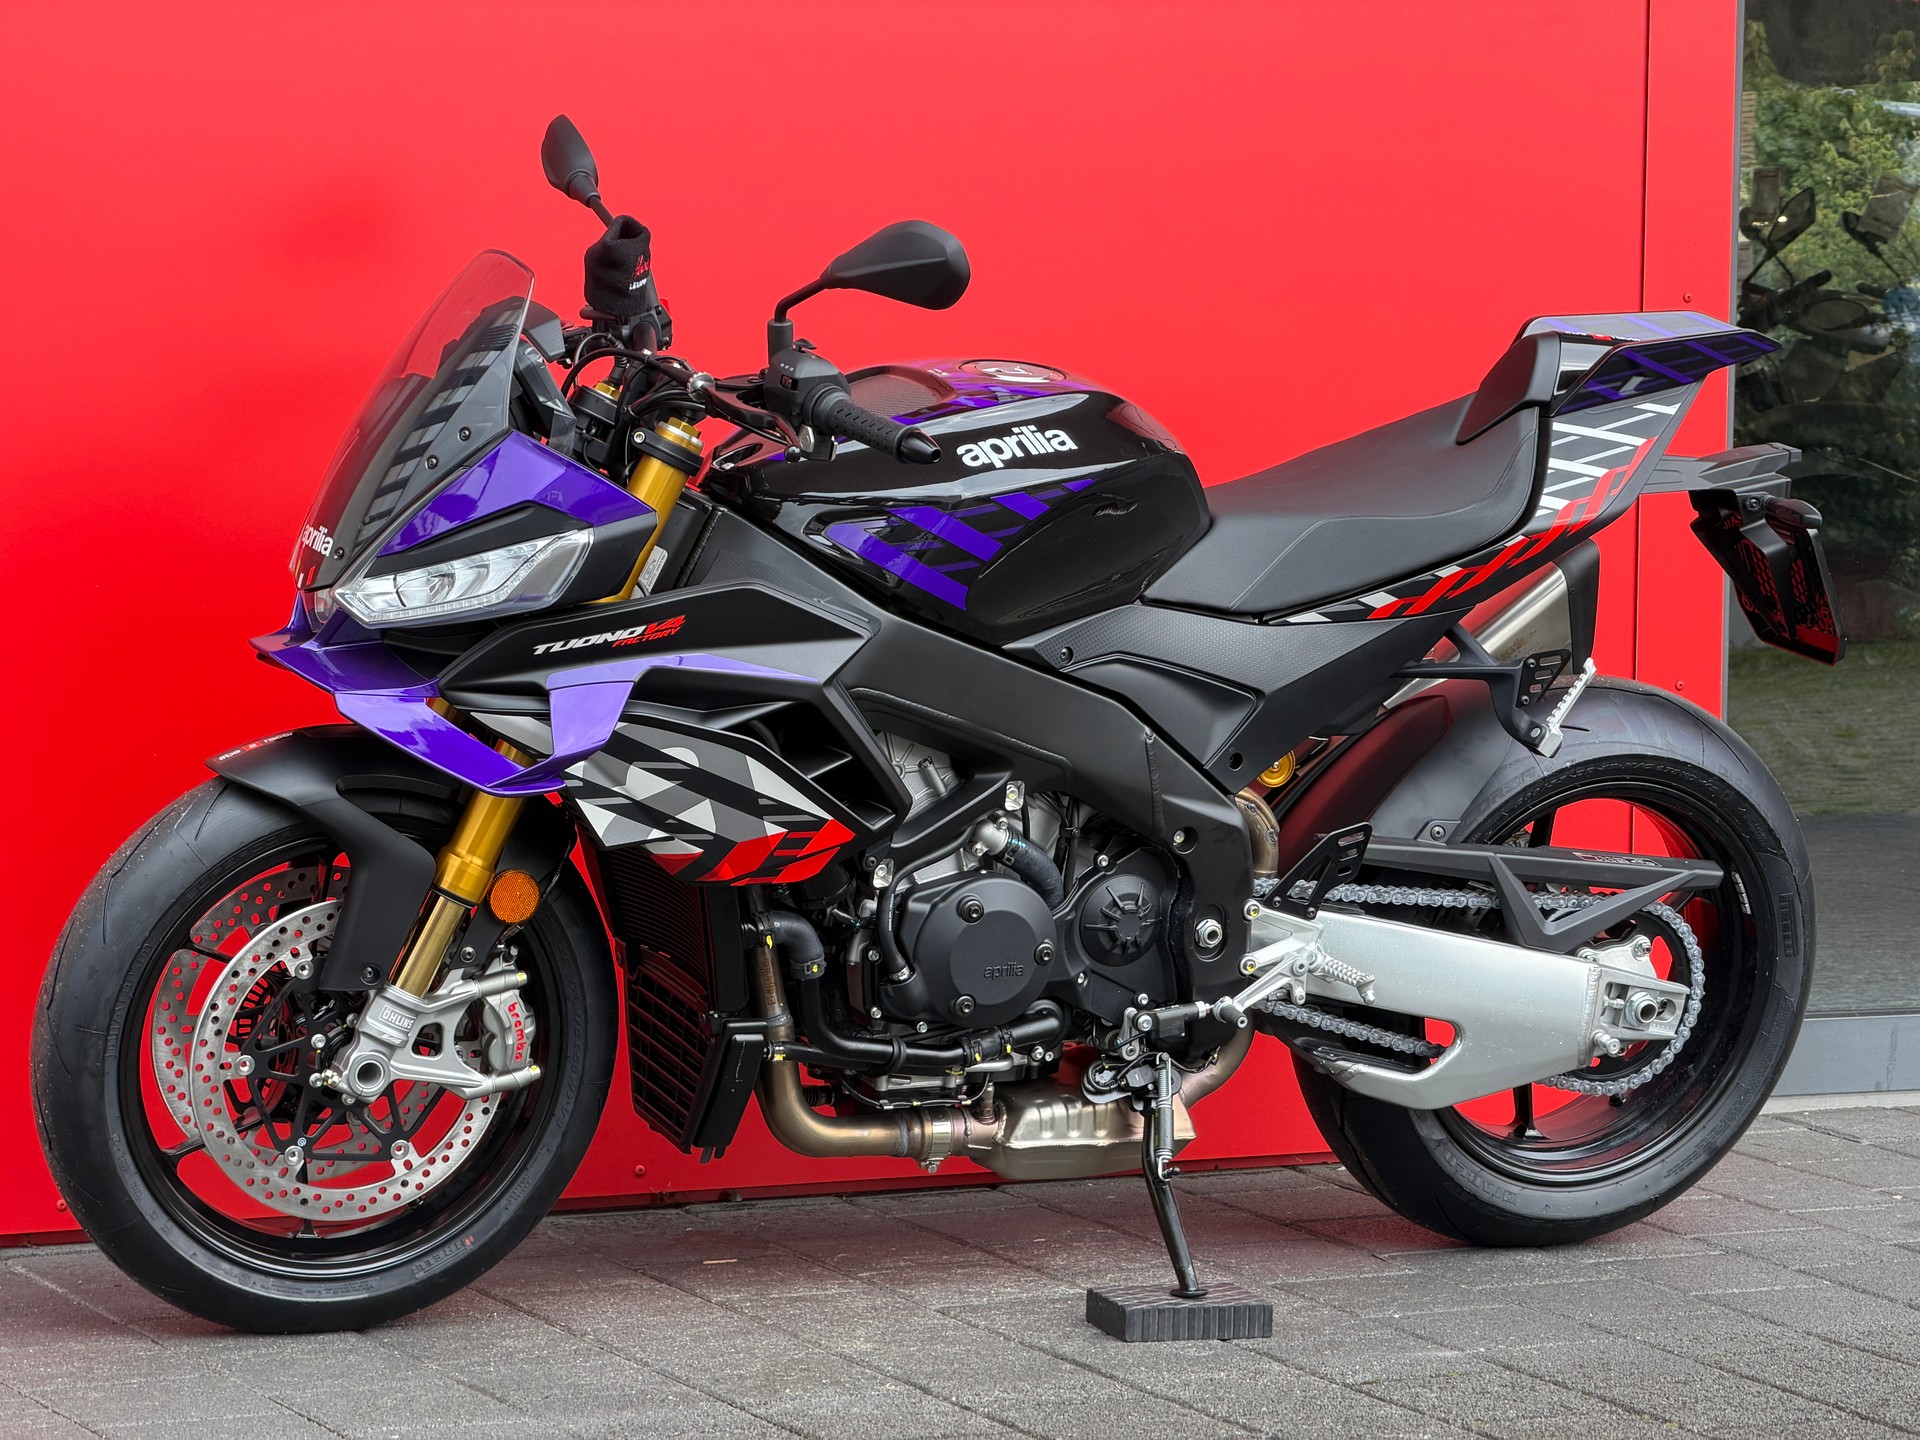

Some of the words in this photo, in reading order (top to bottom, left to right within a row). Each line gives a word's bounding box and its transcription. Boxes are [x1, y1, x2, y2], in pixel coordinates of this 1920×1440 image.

[956, 424, 1079, 468] aprilia
[302, 524, 334, 557] aprilia
[532, 625, 647, 656] TUONO
[645, 614, 687, 635] V4
[611, 627, 681, 648] FACTORY
[263, 732, 294, 743] racer
[983, 961, 1025, 981] aprilia
[382, 1007, 414, 1029] ÖHLINS
[508, 1002, 527, 1062] brembo
